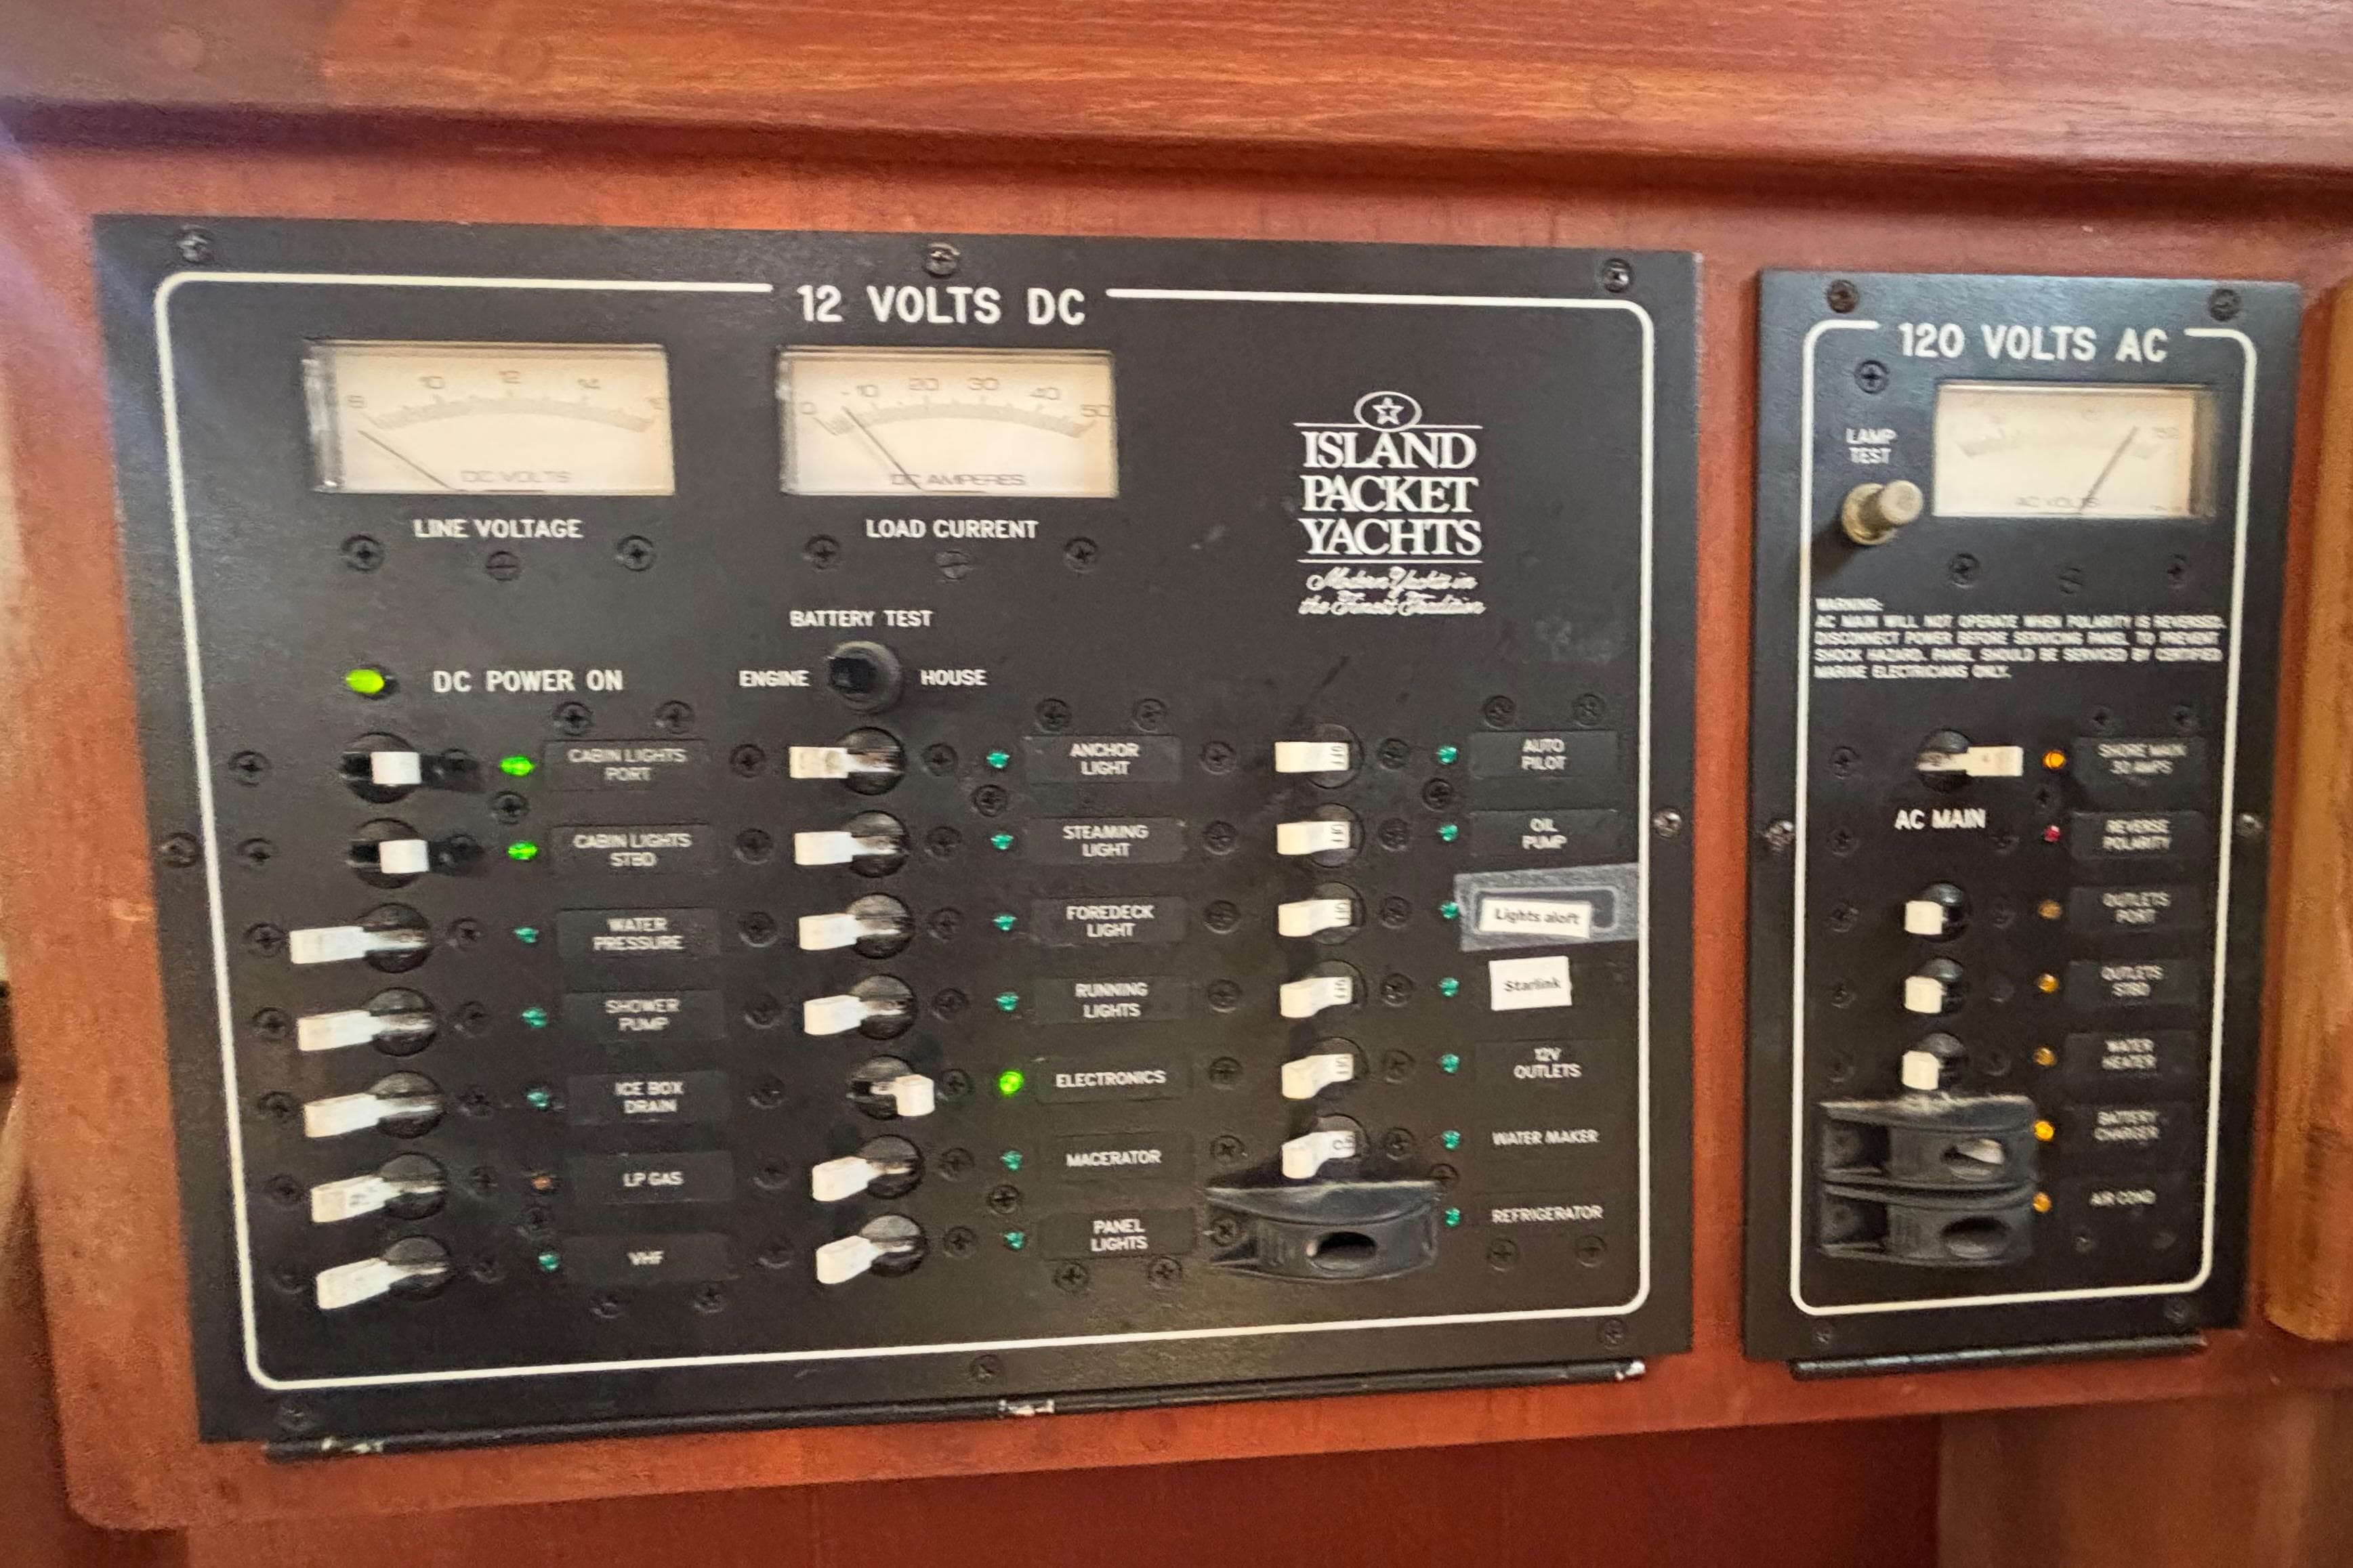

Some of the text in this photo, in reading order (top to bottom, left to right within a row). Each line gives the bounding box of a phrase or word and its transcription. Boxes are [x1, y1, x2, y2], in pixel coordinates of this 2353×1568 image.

[797, 285, 1085, 326] 12 VOLTS DC
[1898, 322, 2167, 362] 120 VOLTS AC
[909, 377, 940, 391] 20
[968, 377, 999, 391] 30
[1846, 428, 1896, 444] LAMP
[1301, 431, 1477, 469] ISLAND
[1848, 448, 1891, 464] TEST
[1299, 474, 1479, 513] PACKET
[413, 519, 584, 538] LINE VOLTAGE
[866, 519, 1039, 538] LOAD CURRENT
[1297, 518, 1482, 556] YACHTS
[790, 610, 933, 627] BATTERY TEST
[434, 670, 623, 692] DC POWER ON
[739, 671, 810, 687] ENGINE
[921, 669, 988, 686] HOUSE
[1070, 743, 1140, 757] ANCHOR
[1522, 738, 1565, 753] AUTO
[567, 748, 688, 763] CABIN LIGHTS
[1081, 761, 1131, 775] LIGHT
[1521, 757, 1567, 770] PILOT
[604, 767, 652, 782] PORT
[1530, 818, 1558, 832] OIL
[1896, 809, 1986, 830] AC MAIN
[1063, 825, 1149, 839] STEAMING
[573, 833, 692, 848] CABIN LIGHTS
[1522, 835, 1567, 849] PUMP
[1082, 843, 1131, 857] LIGHT
[1066, 905, 1154, 920] FOREDECK
[1495, 908, 1581, 925] Lights aloft
[607, 917, 667, 932] WATER
[1086, 923, 1136, 937] LIGHT
[592, 935, 684, 950] PRESSURE
[1075, 982, 1148, 998] RUNNING
[1504, 977, 1561, 992] Starlink
[605, 998, 680, 1013] SHOWER
[1084, 1003, 1141, 1018] LIGHTS
[619, 1017, 669, 1032] PUMP
[1514, 1064, 1582, 1078] OUTLETS
[1056, 1071, 1167, 1088] ELECTRONICS
[615, 1081, 685, 1095] ICE BOX
[624, 1099, 677, 1114] DRAIN
[1493, 1129, 1600, 1145] WATER MAKER
[1066, 1150, 1162, 1166] MACERATOR
[623, 1171, 684, 1187] LP GAS
[1492, 1205, 1604, 1223] REFRIGERATOR
[1093, 1219, 1145, 1233] PANEL
[1091, 1236, 1148, 1252] LIGHTS
[627, 1250, 664, 1265] VHF
